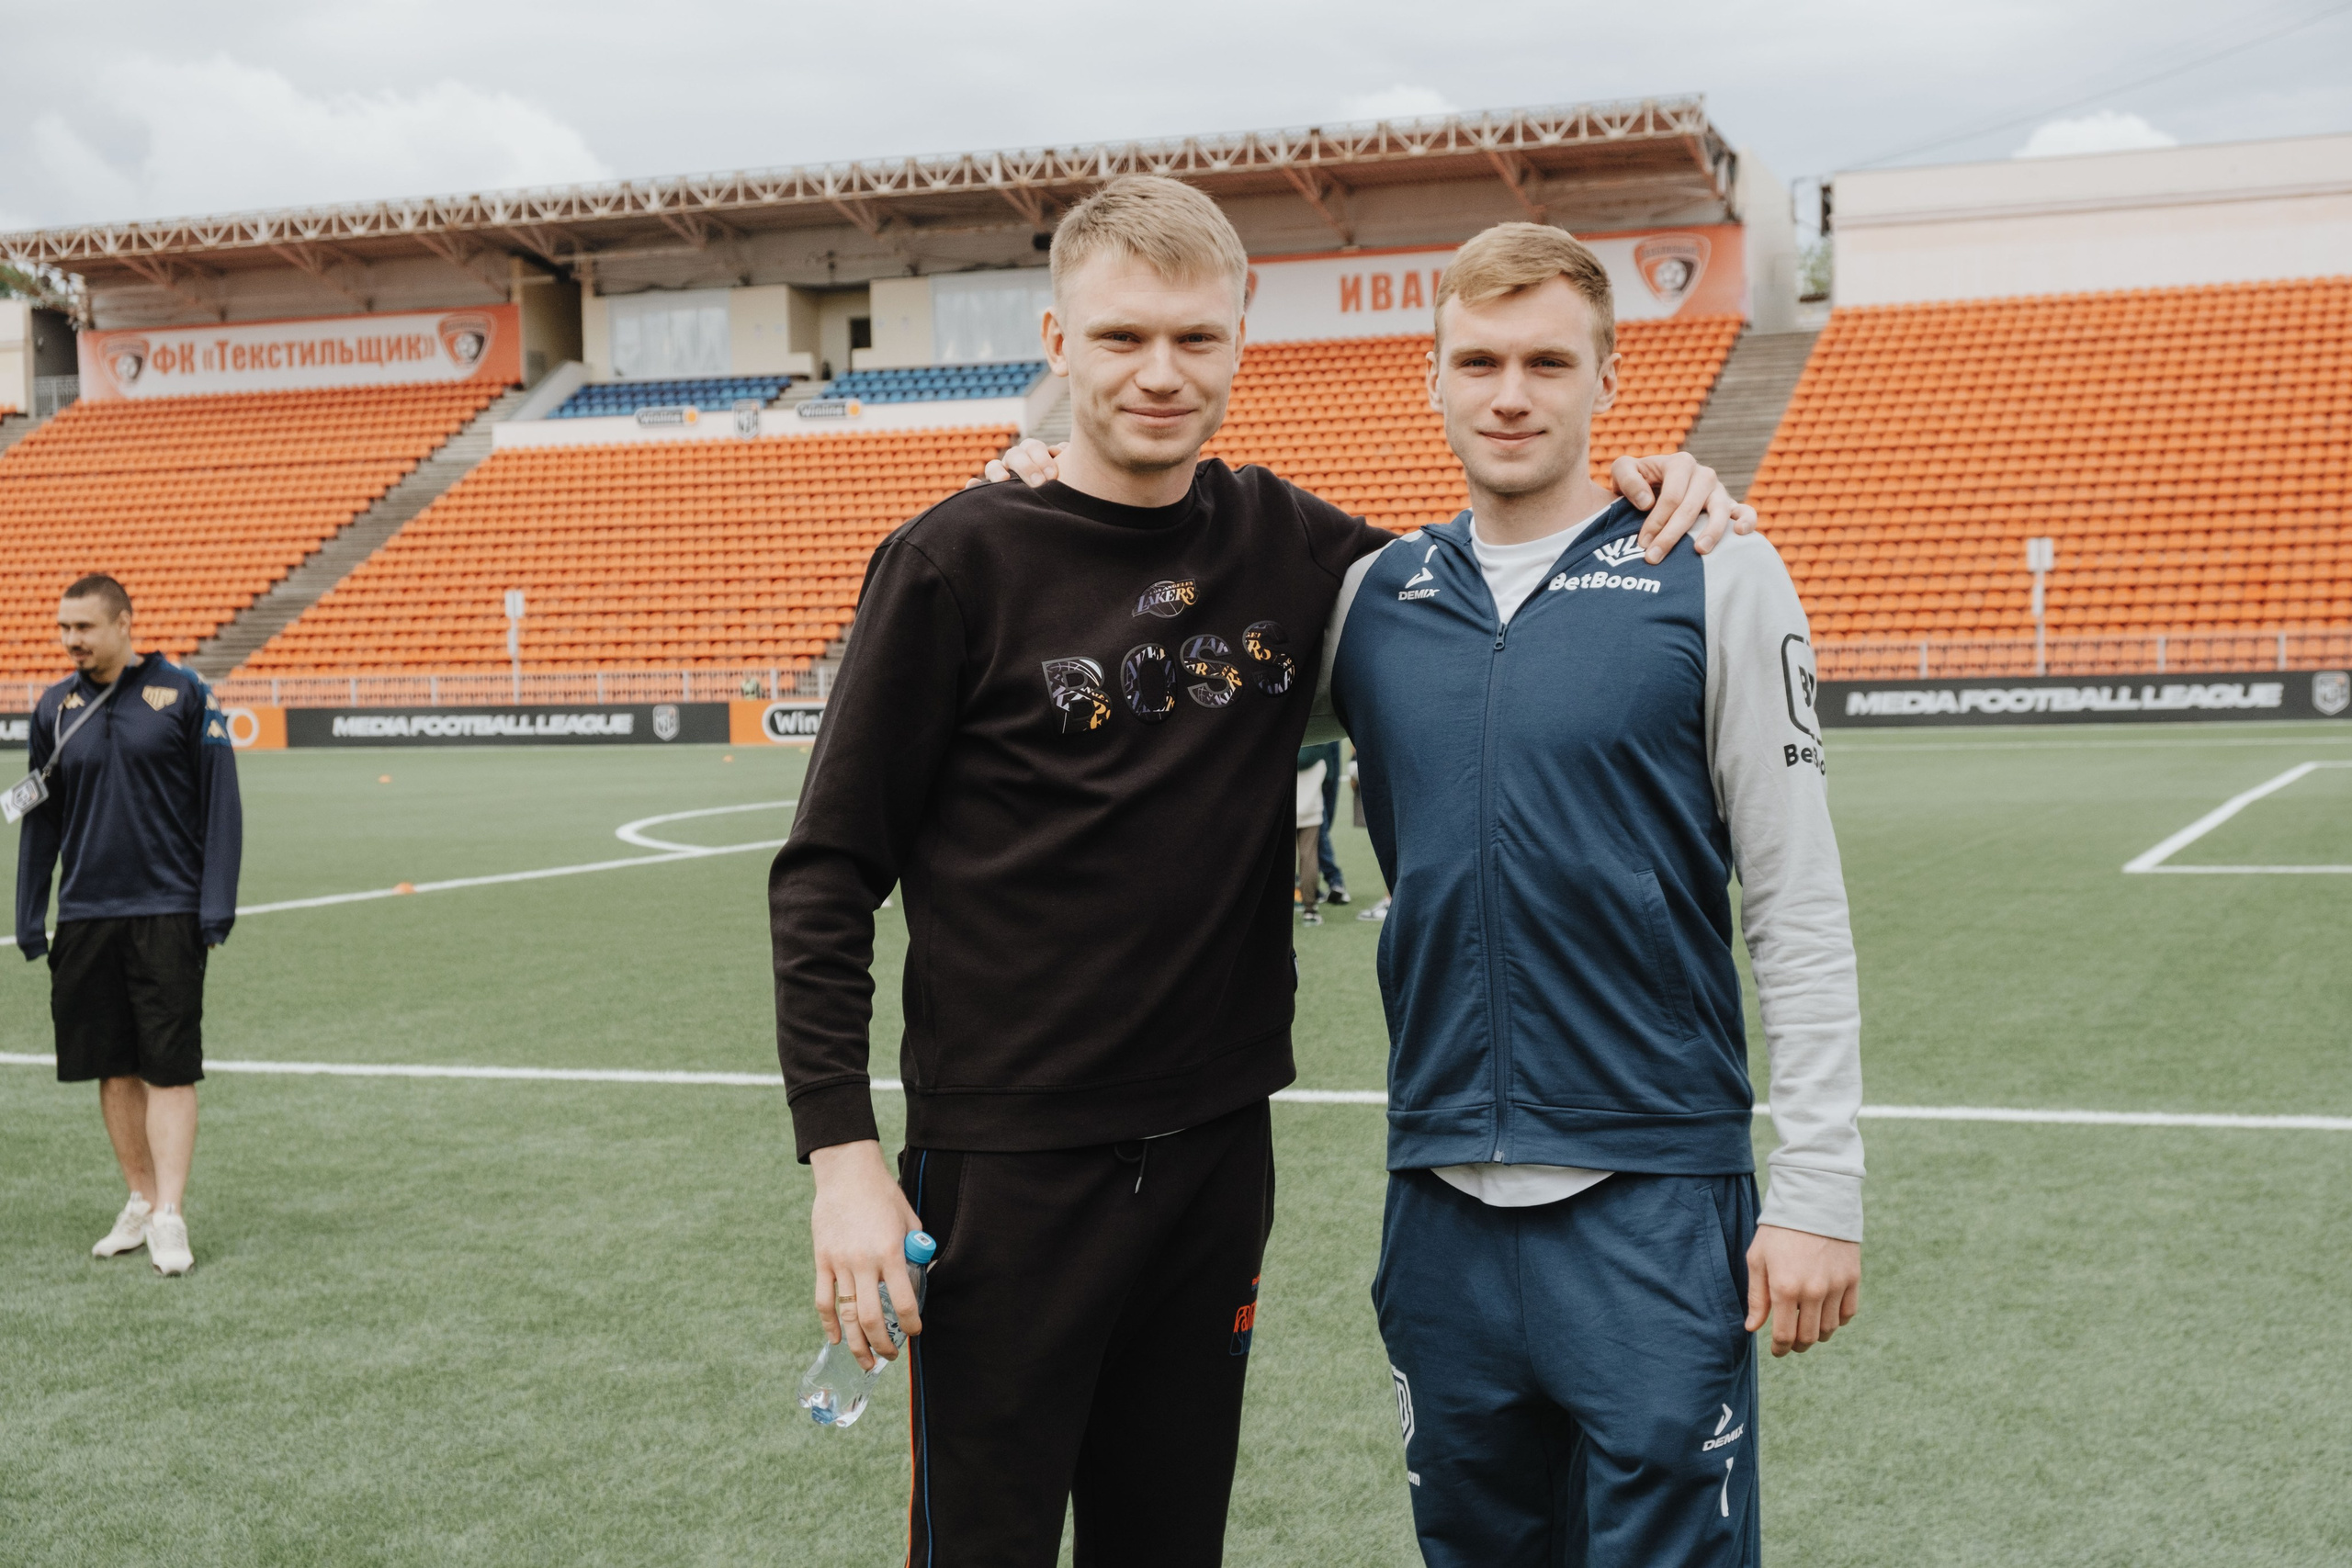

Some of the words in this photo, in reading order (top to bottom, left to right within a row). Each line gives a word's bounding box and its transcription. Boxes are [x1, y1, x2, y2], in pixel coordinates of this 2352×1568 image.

[153, 342, 196, 375] ФК
[1397, 588, 1441, 601] DEMIX
[1548, 571, 1661, 593] BetBoom
[1137, 586, 1195, 613] LAKERS
[1041, 620, 1297, 733] BOSS
[1846, 691, 1959, 716] MEDIA
[1958, 687, 2141, 714] FOOTBALL
[2141, 682, 2283, 710] LEAGUE
[333, 715, 410, 737] MEDIA
[410, 715, 535, 737] FOOTBALL
[535, 713, 634, 736] LEAGUE
[1702, 1423, 1744, 1451] DEMIX
